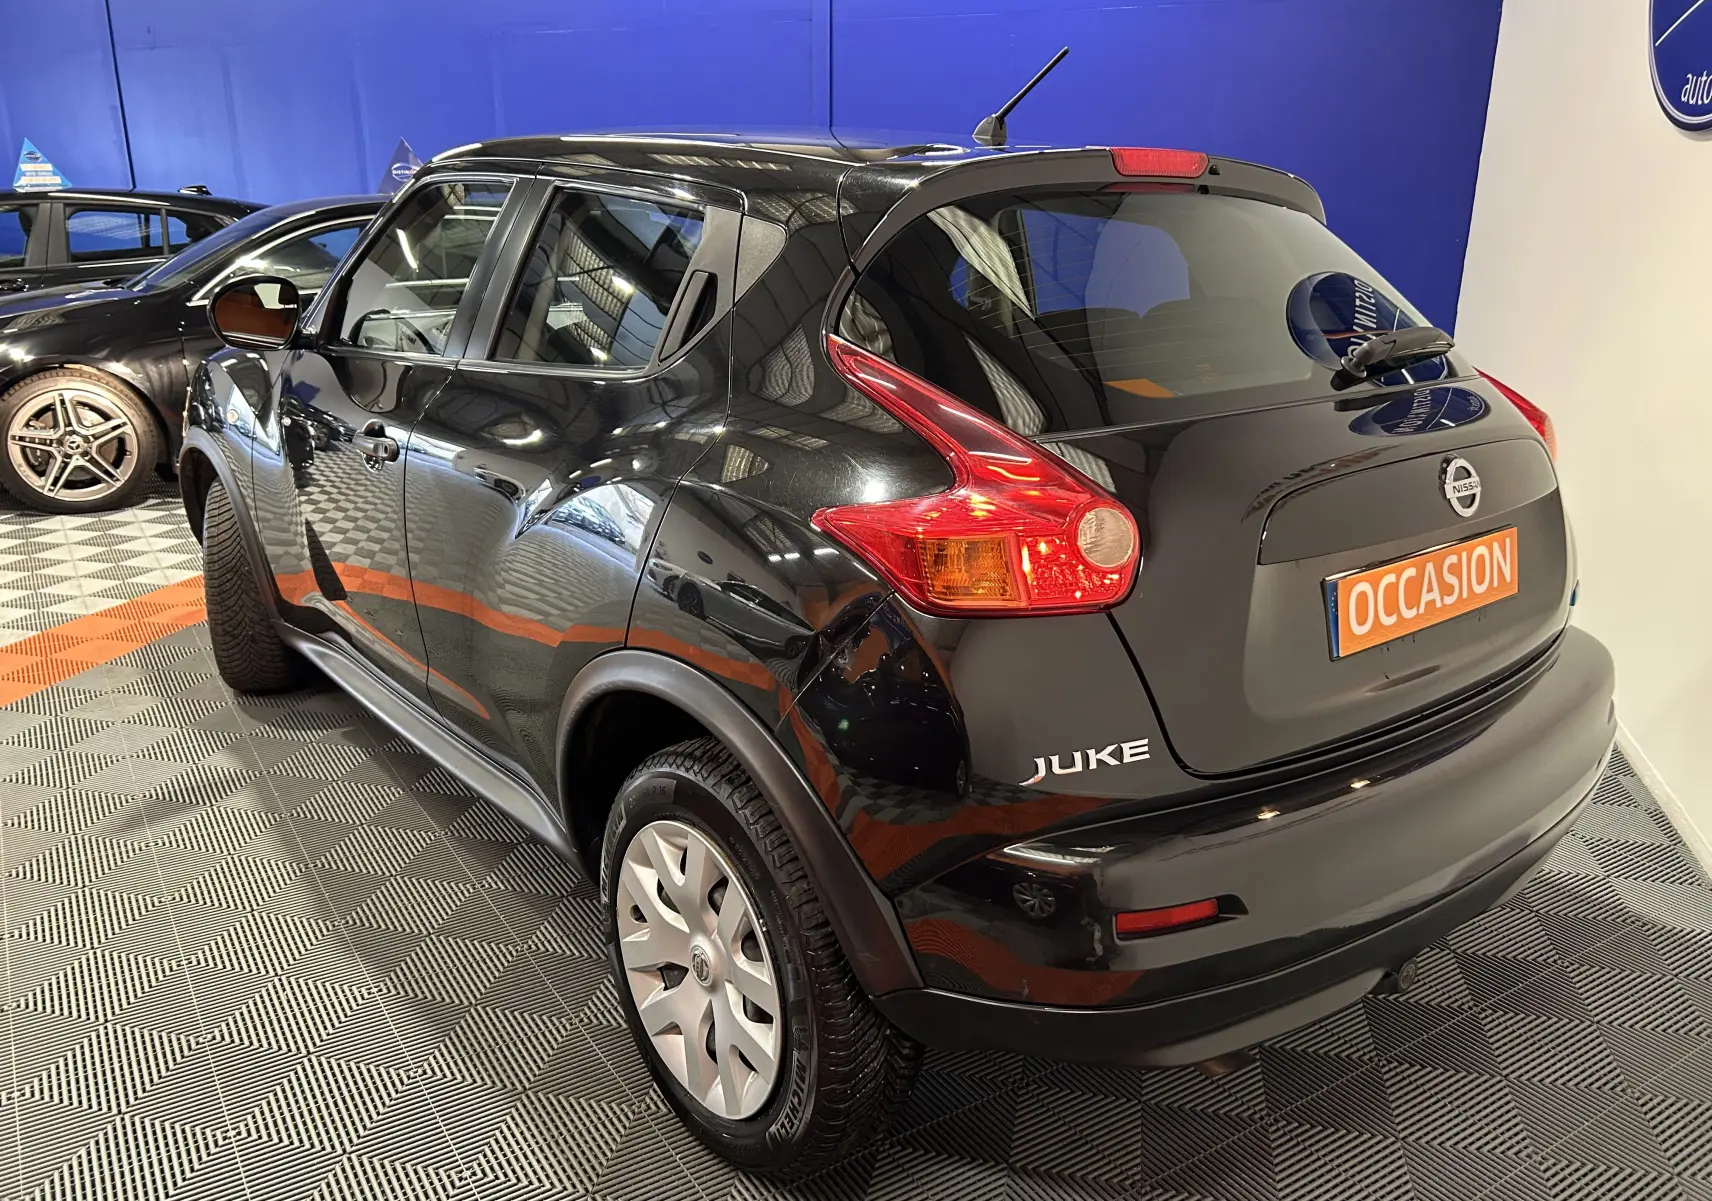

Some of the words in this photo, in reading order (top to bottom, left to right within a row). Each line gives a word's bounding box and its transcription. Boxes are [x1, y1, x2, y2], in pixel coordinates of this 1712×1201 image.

[1681, 70, 1712, 105] auto
[1452, 480, 1480, 494] NISSAN
[1348, 537, 1512, 636] OCCASION
[1018, 738, 1151, 786] JUKE
